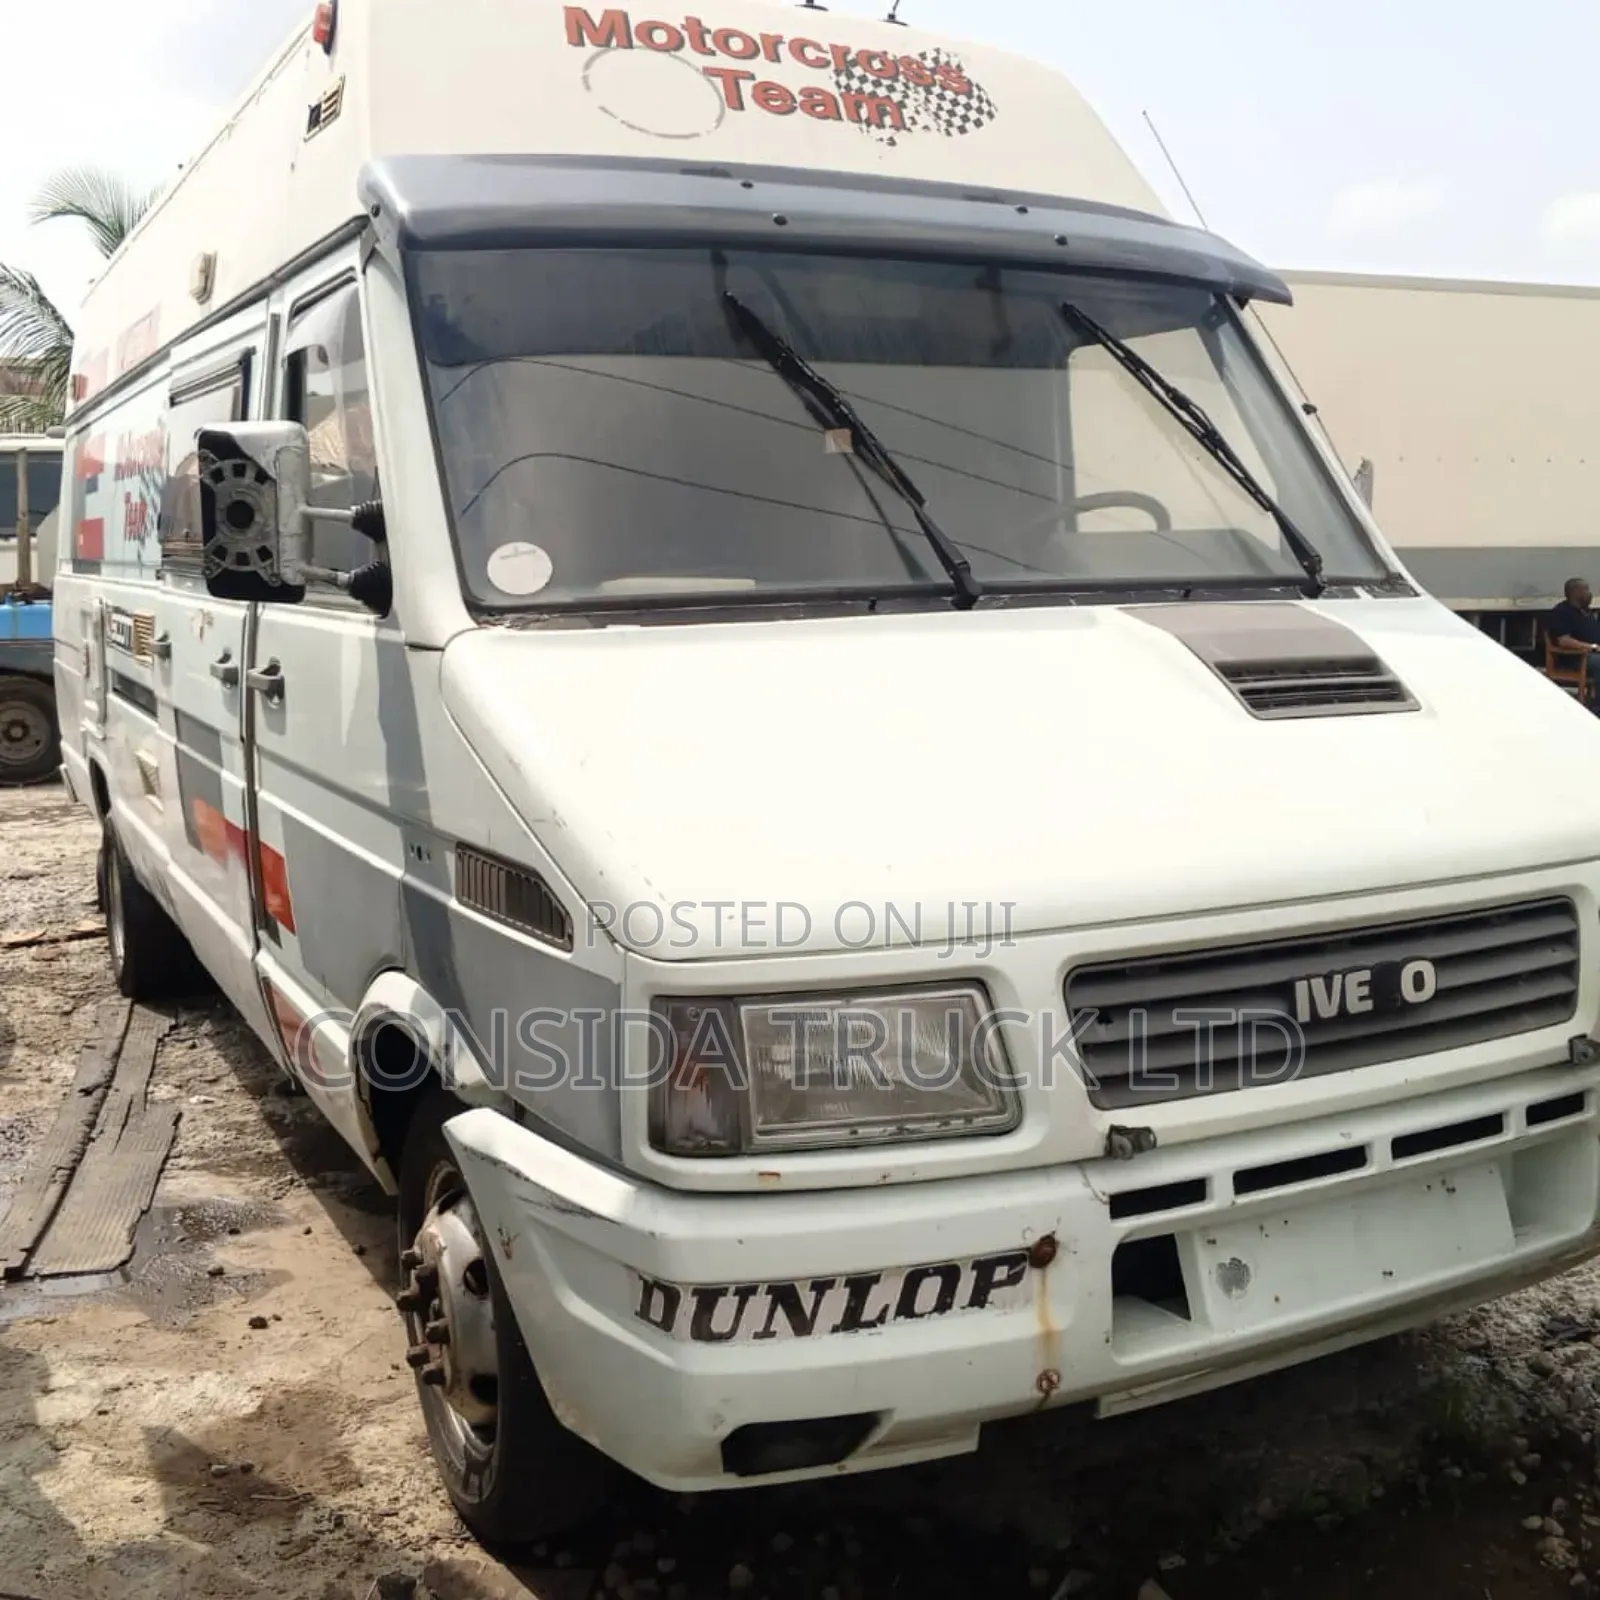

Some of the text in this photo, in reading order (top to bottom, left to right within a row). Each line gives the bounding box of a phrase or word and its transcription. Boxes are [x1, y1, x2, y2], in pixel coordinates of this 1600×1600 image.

[563, 6, 974, 96] Motorcross
[703, 66, 906, 131] Team
[1295, 960, 1436, 1023] IVEO
[634, 1251, 1029, 1342] DUNLOP
